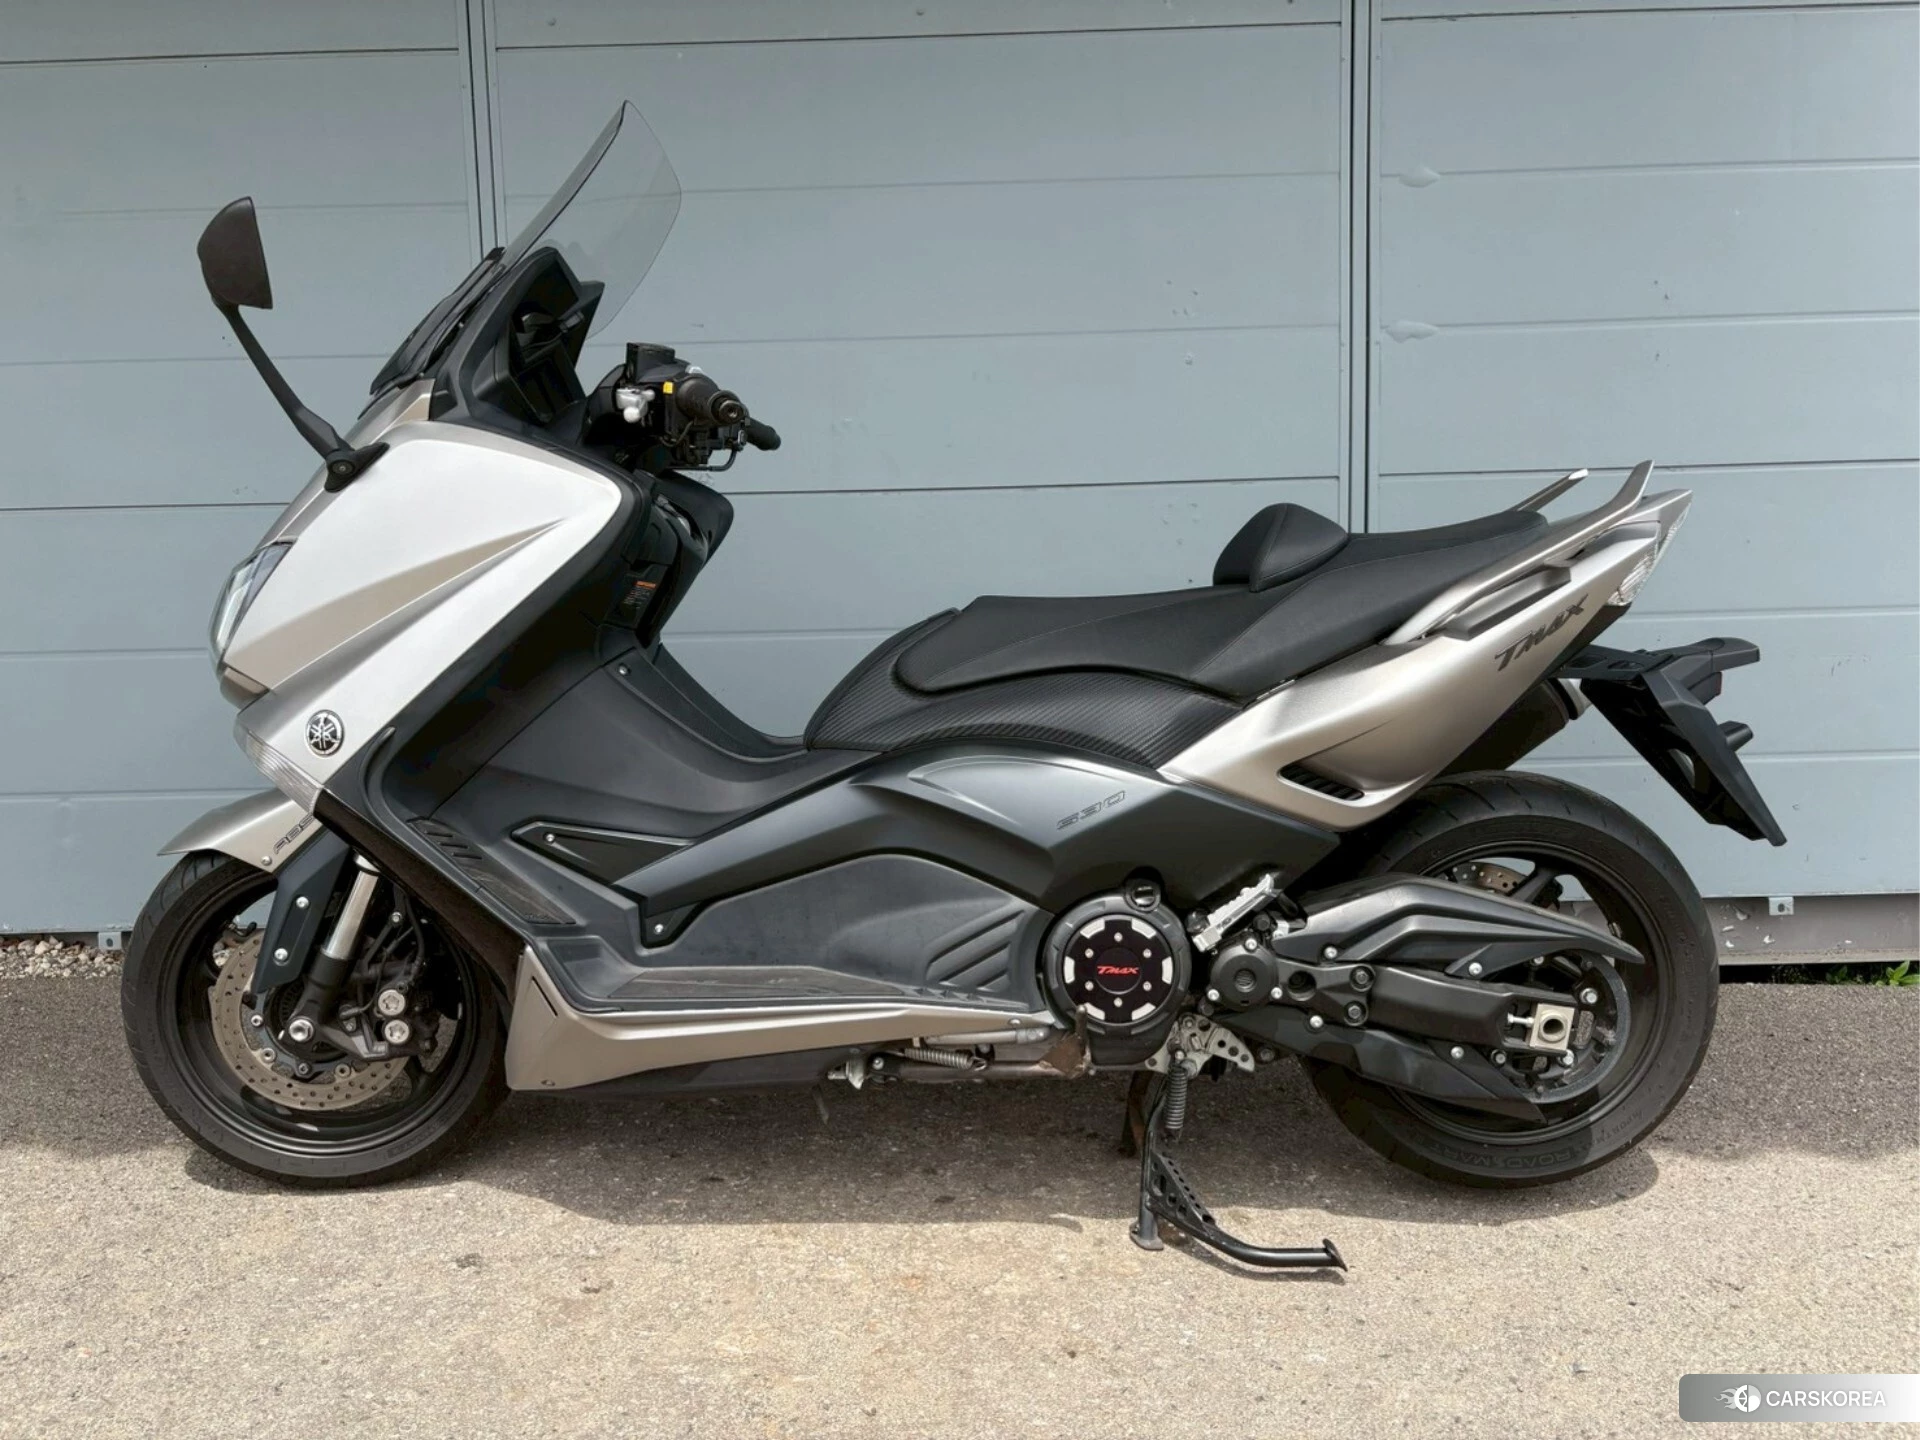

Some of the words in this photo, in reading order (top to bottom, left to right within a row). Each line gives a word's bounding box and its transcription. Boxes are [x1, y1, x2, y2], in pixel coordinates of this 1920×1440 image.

[1494, 593, 1589, 671] TMAX
[1057, 791, 1125, 830] 530
[273, 813, 314, 855] ABS
[1097, 965, 1139, 974] TMAX
